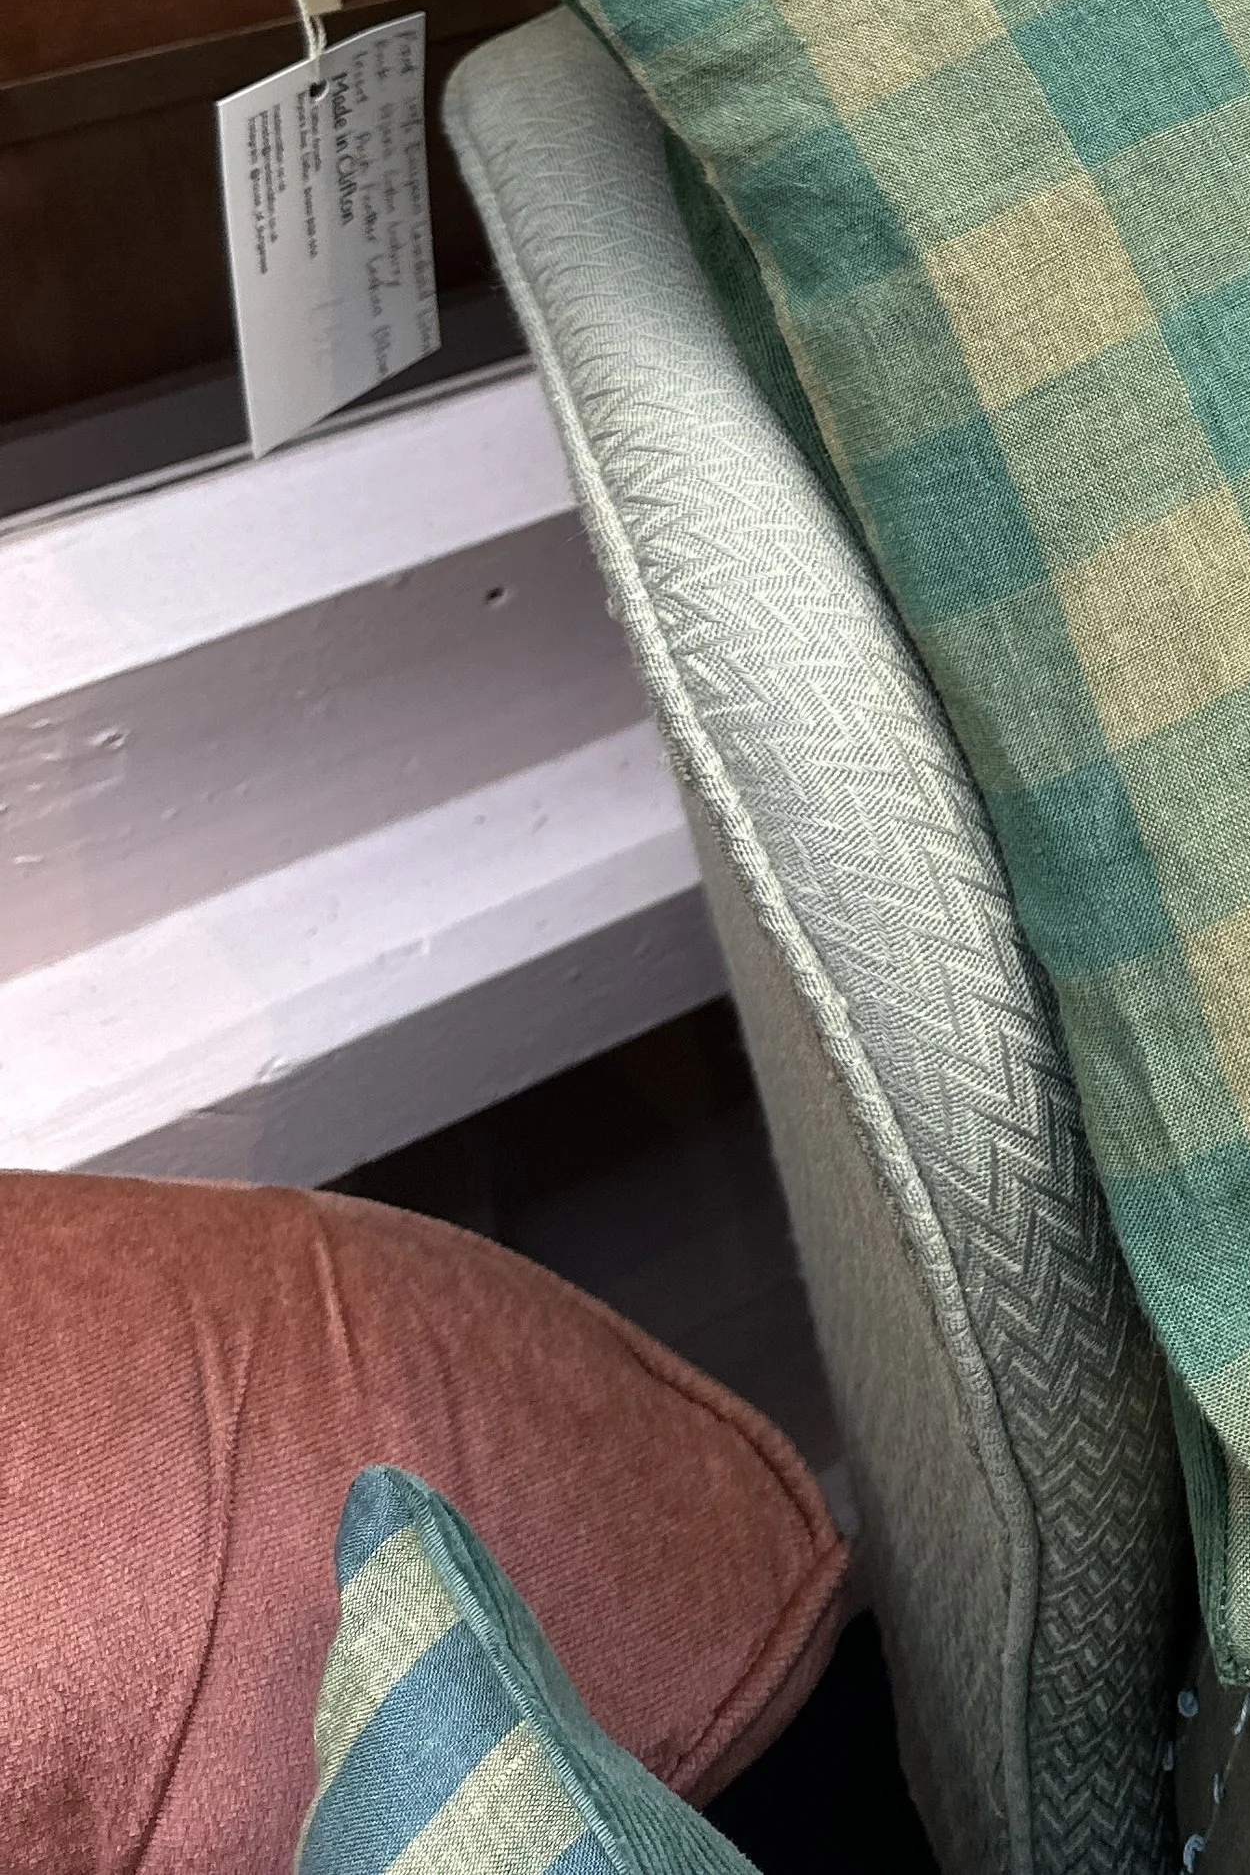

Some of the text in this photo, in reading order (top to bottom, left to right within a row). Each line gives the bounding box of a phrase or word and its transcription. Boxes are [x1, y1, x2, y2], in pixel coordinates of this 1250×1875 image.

[331, 71, 358, 225] Made in Clifton
